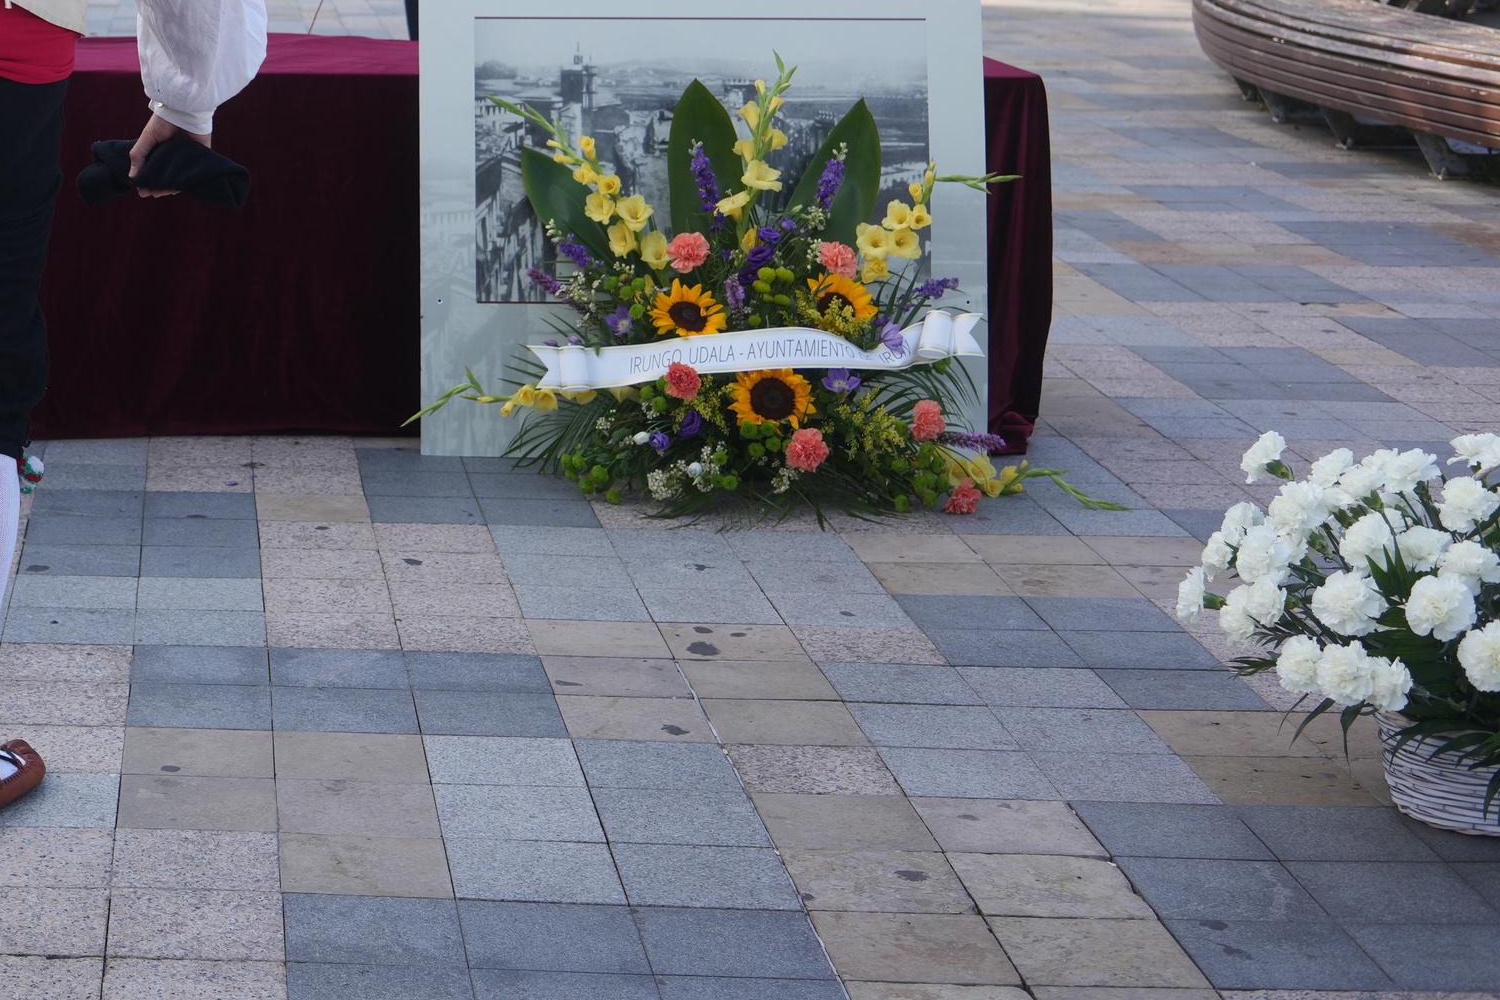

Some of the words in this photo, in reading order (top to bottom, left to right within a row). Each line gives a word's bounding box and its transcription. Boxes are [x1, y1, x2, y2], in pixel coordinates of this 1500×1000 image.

[629, 348, 682, 374] IRUNGO
[688, 344, 735, 365] UDALA
[746, 338, 855, 361] AYUNTAMIENTO
